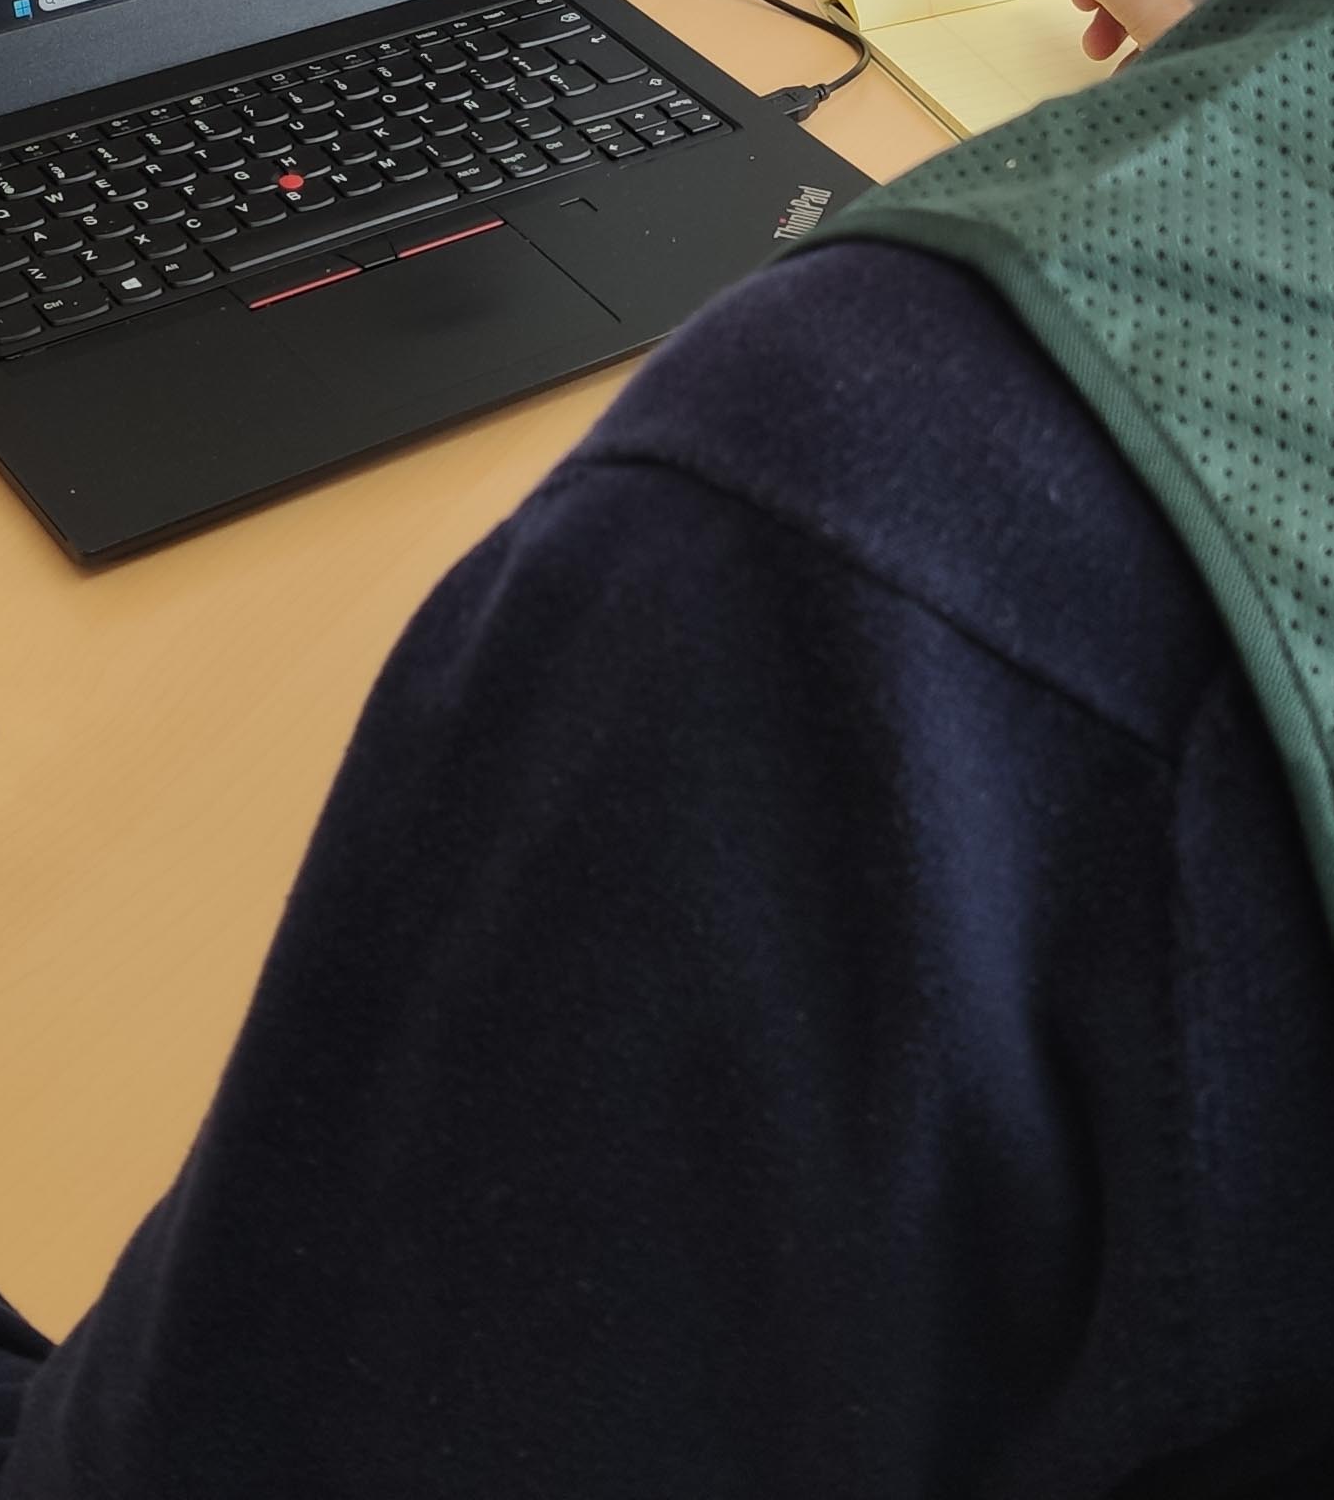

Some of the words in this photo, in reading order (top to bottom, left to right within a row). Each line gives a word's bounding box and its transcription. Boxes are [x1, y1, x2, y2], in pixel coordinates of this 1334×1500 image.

[382, 94, 397, 104] O
[289, 121, 304, 131] U
[374, 127, 390, 137] K
[280, 156, 297, 167] H
[378, 158, 396, 169] M
[234, 171, 250, 180] G
[331, 173, 347, 184] N
[183, 185, 196, 196] F
[286, 191, 302, 201] B
[44, 192, 64, 203] W
[133, 200, 149, 210] D
[773, 184, 832, 240] ThinkPad
[82, 215, 98, 226] S
[186, 218, 202, 229] C
[33, 231, 48, 242] A
[134, 233, 151, 245] X
[81, 250, 98, 261] Z
[43, 299, 64, 310] Ctrl
